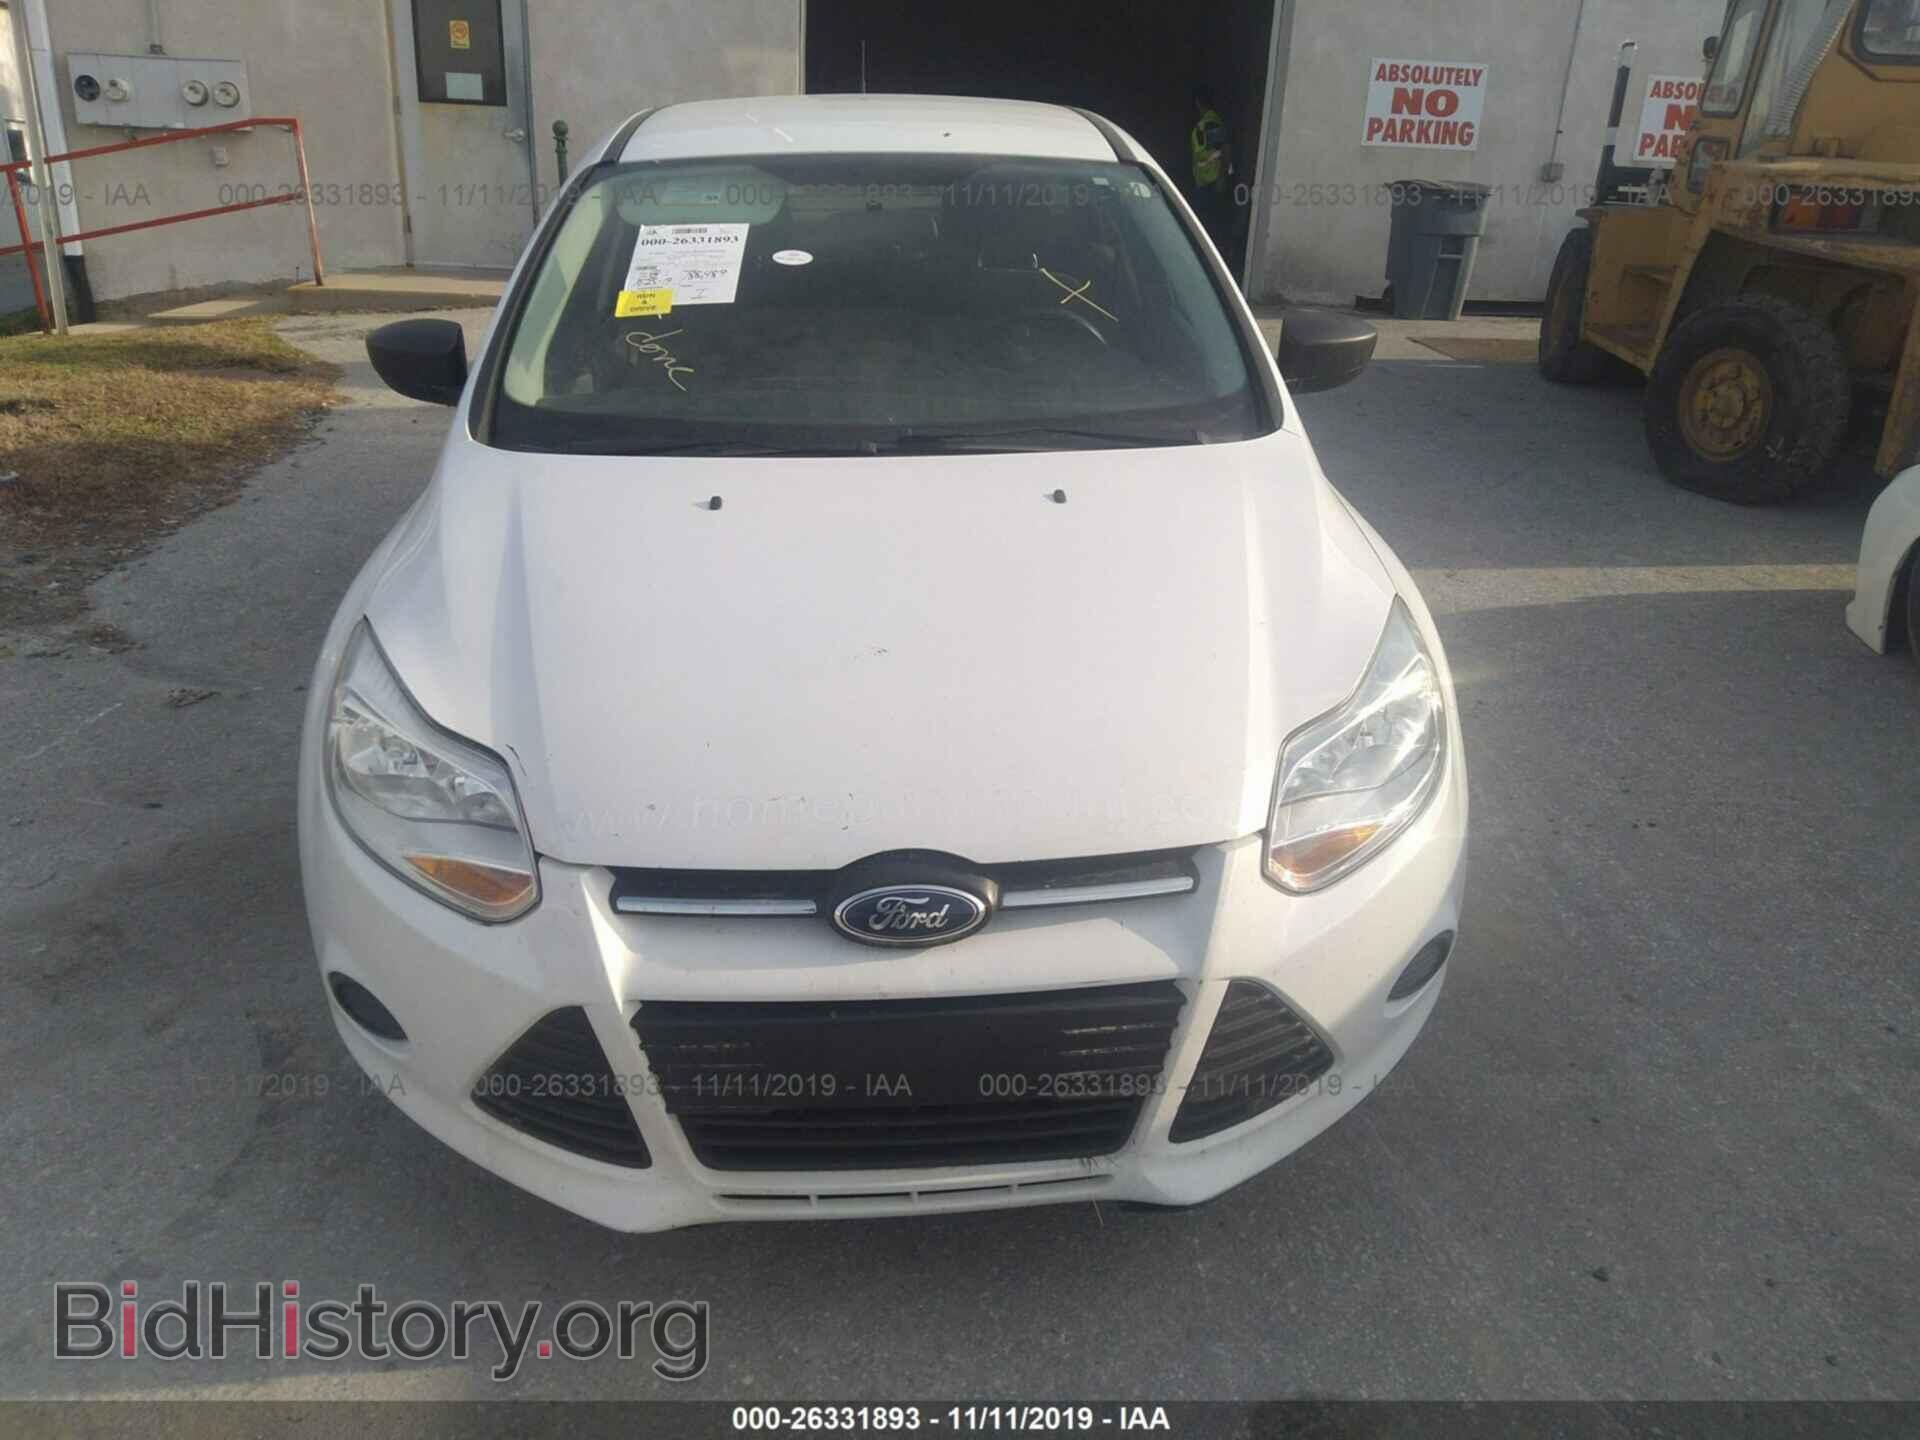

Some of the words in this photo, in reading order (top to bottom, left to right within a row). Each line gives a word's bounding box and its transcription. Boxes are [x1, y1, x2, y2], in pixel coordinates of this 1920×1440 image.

[1375, 63, 1483, 87] ABSOLUTELY
[1391, 87, 1459, 118] NO
[1366, 117, 1475, 147] PARKING
[868, 896, 950, 931] Ford
